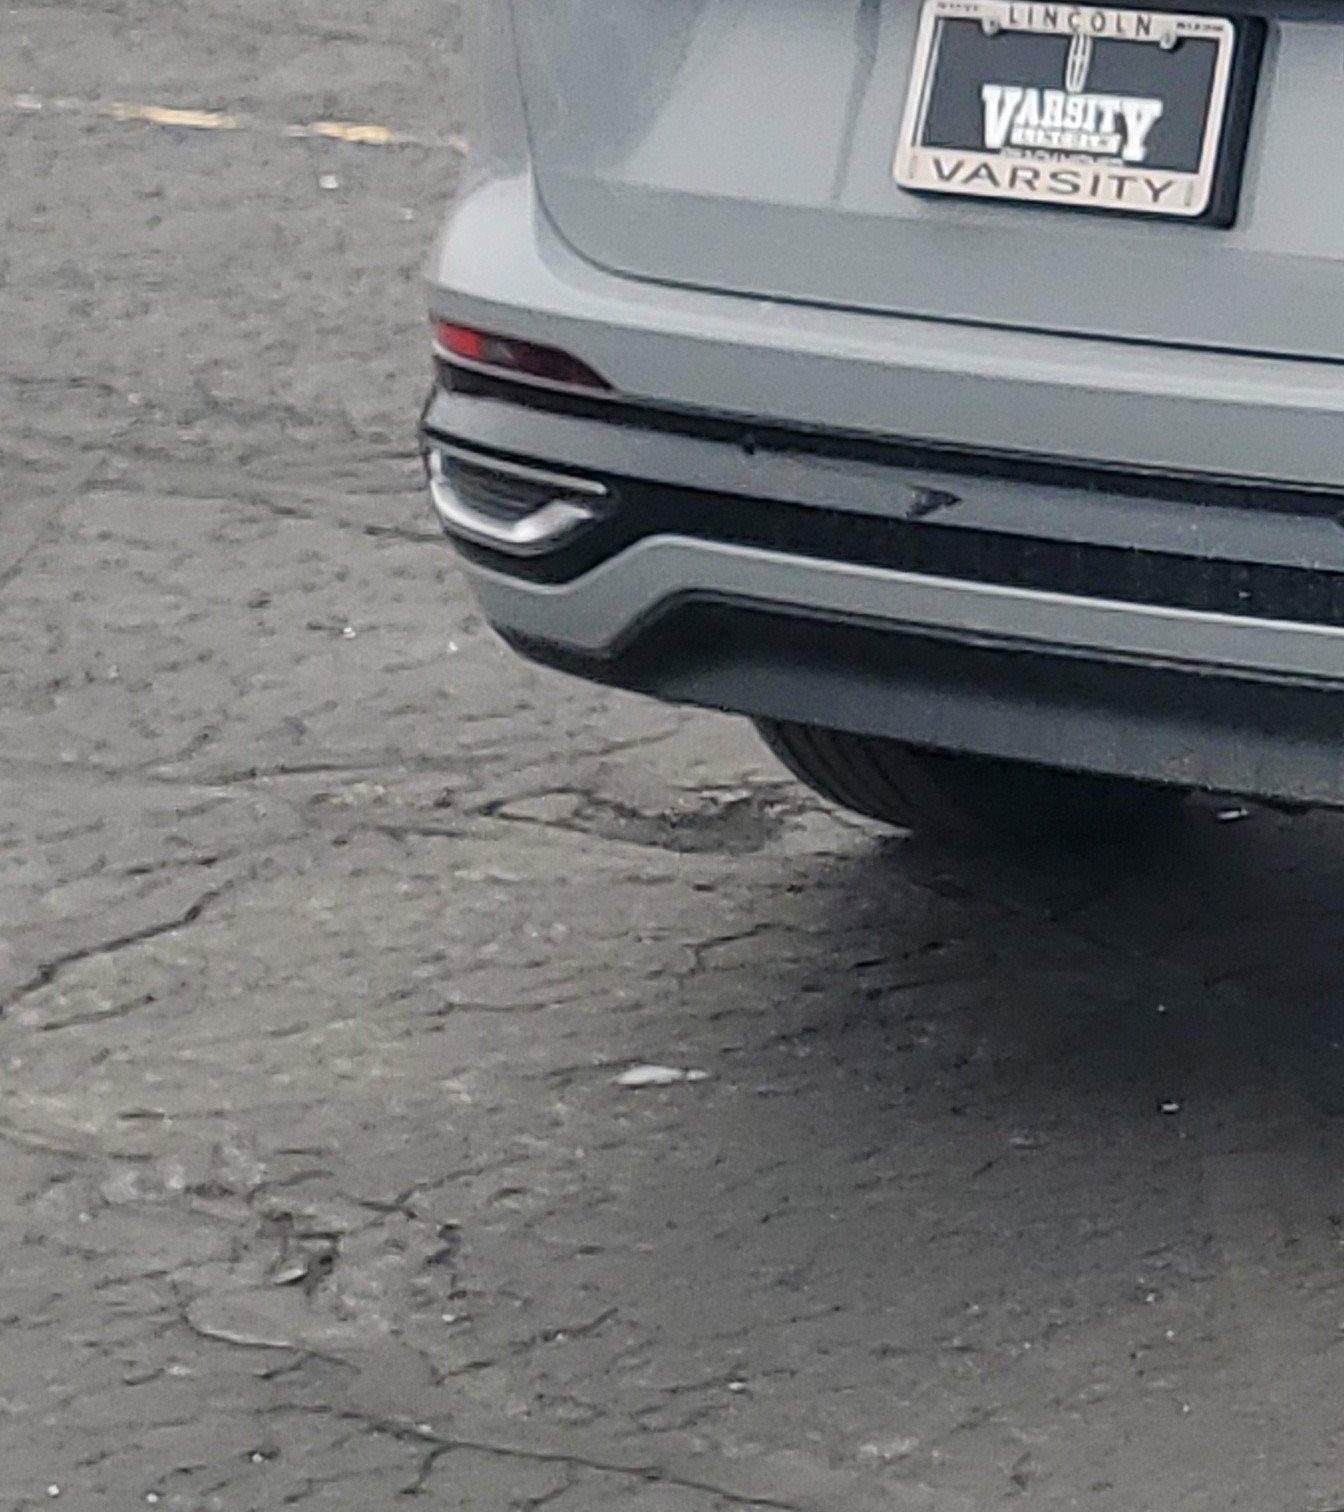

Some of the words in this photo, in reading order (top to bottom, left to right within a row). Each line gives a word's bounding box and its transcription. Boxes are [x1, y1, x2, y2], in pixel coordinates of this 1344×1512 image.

[1008, 3, 1154, 37] LINCOLN
[981, 84, 1163, 161] VARSITY
[931, 157, 1174, 204] VARSITY
